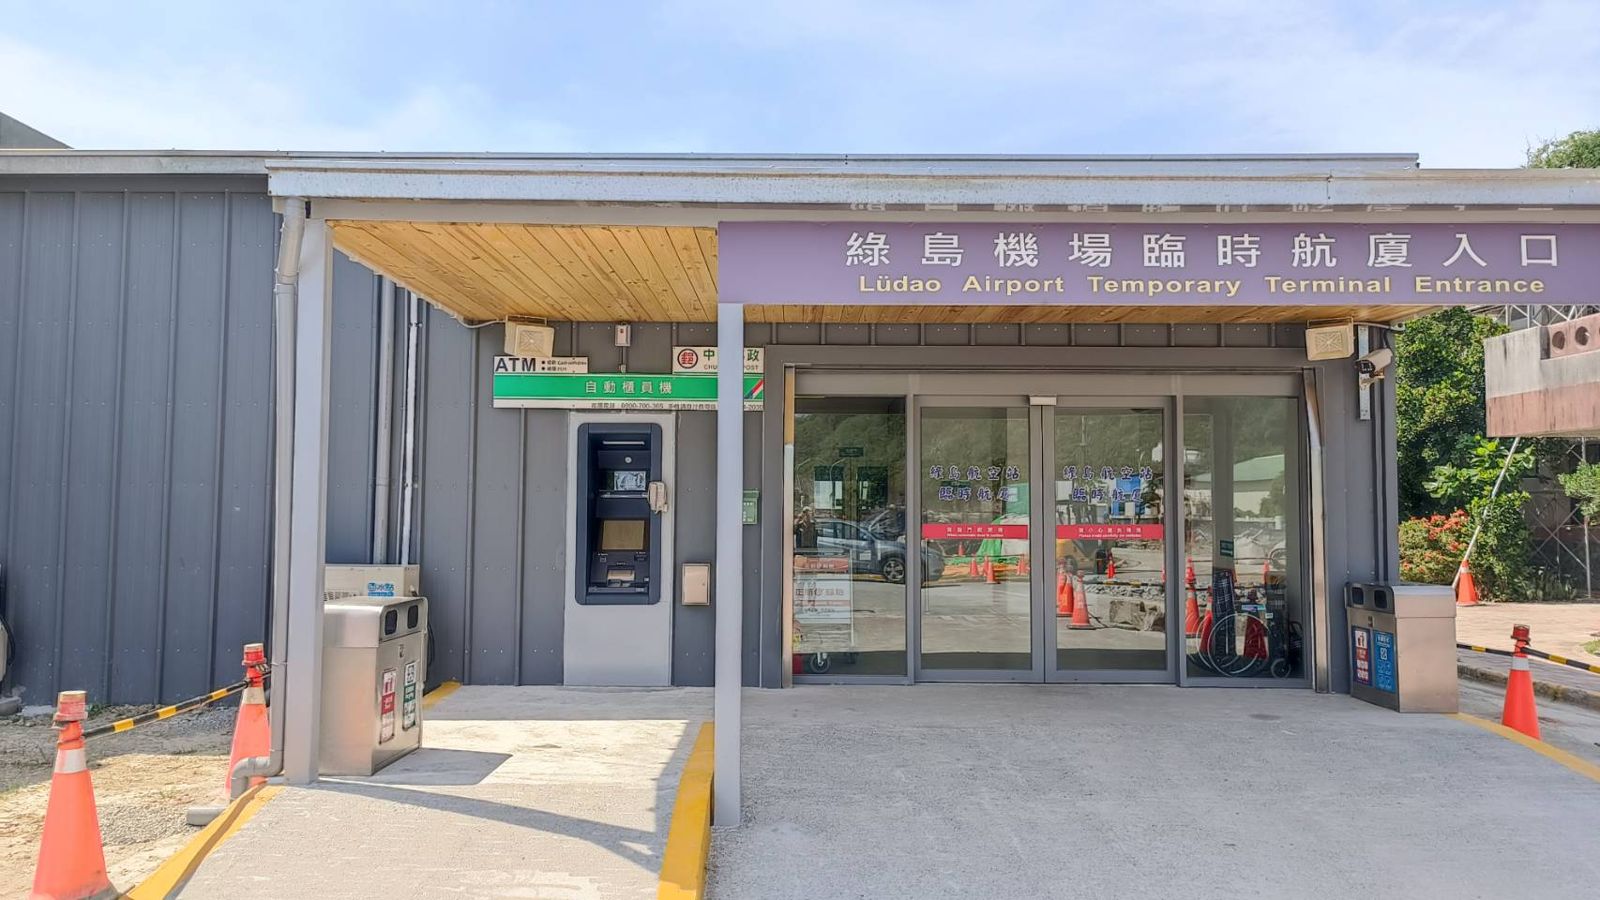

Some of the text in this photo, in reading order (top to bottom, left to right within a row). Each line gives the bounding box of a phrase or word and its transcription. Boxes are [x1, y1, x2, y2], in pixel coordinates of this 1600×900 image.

[845, 232, 1559, 268] 綠島機場臨時航廈入口
[859, 275, 1545, 297] Lüdao Airport Temporary Terminal Entrance
[495, 357, 537, 372] ATM
[585, 380, 673, 395] 自動櫃員機
[930, 465, 1020, 481] 綠島航空站
[1063, 465, 1153, 481] 綠島航空站
